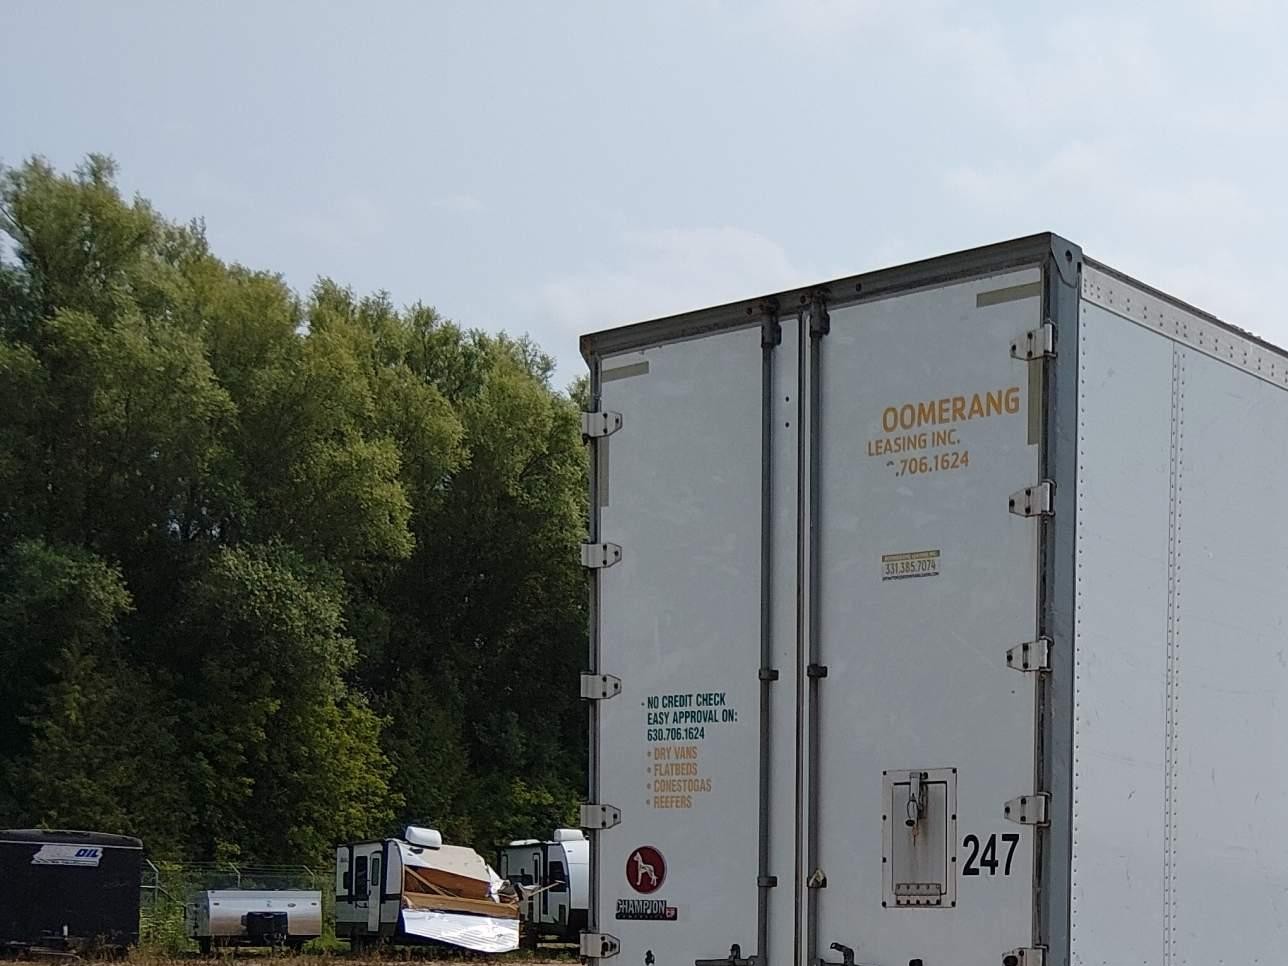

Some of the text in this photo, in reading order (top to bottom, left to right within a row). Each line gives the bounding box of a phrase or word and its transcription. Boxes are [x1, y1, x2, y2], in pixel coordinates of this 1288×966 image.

[882, 387, 1020, 433] OOMERANG
[867, 428, 961, 457] LEASING INC.
[886, 450, 970, 478] .706.1624
[647, 692, 727, 710] NO CREDIT CHECK
[647, 708, 739, 726] EASY APPROVAL ON:
[647, 727, 706, 742] 630.706.1624
[653, 746, 699, 761] DRY VANS
[653, 762, 699, 777] FLATBEDS
[653, 778, 713, 793] CONESTOGAS
[653, 795, 694, 809] REEFERS
[962, 833, 1021, 877] 247
[616, 899, 666, 914] CHAMPION
